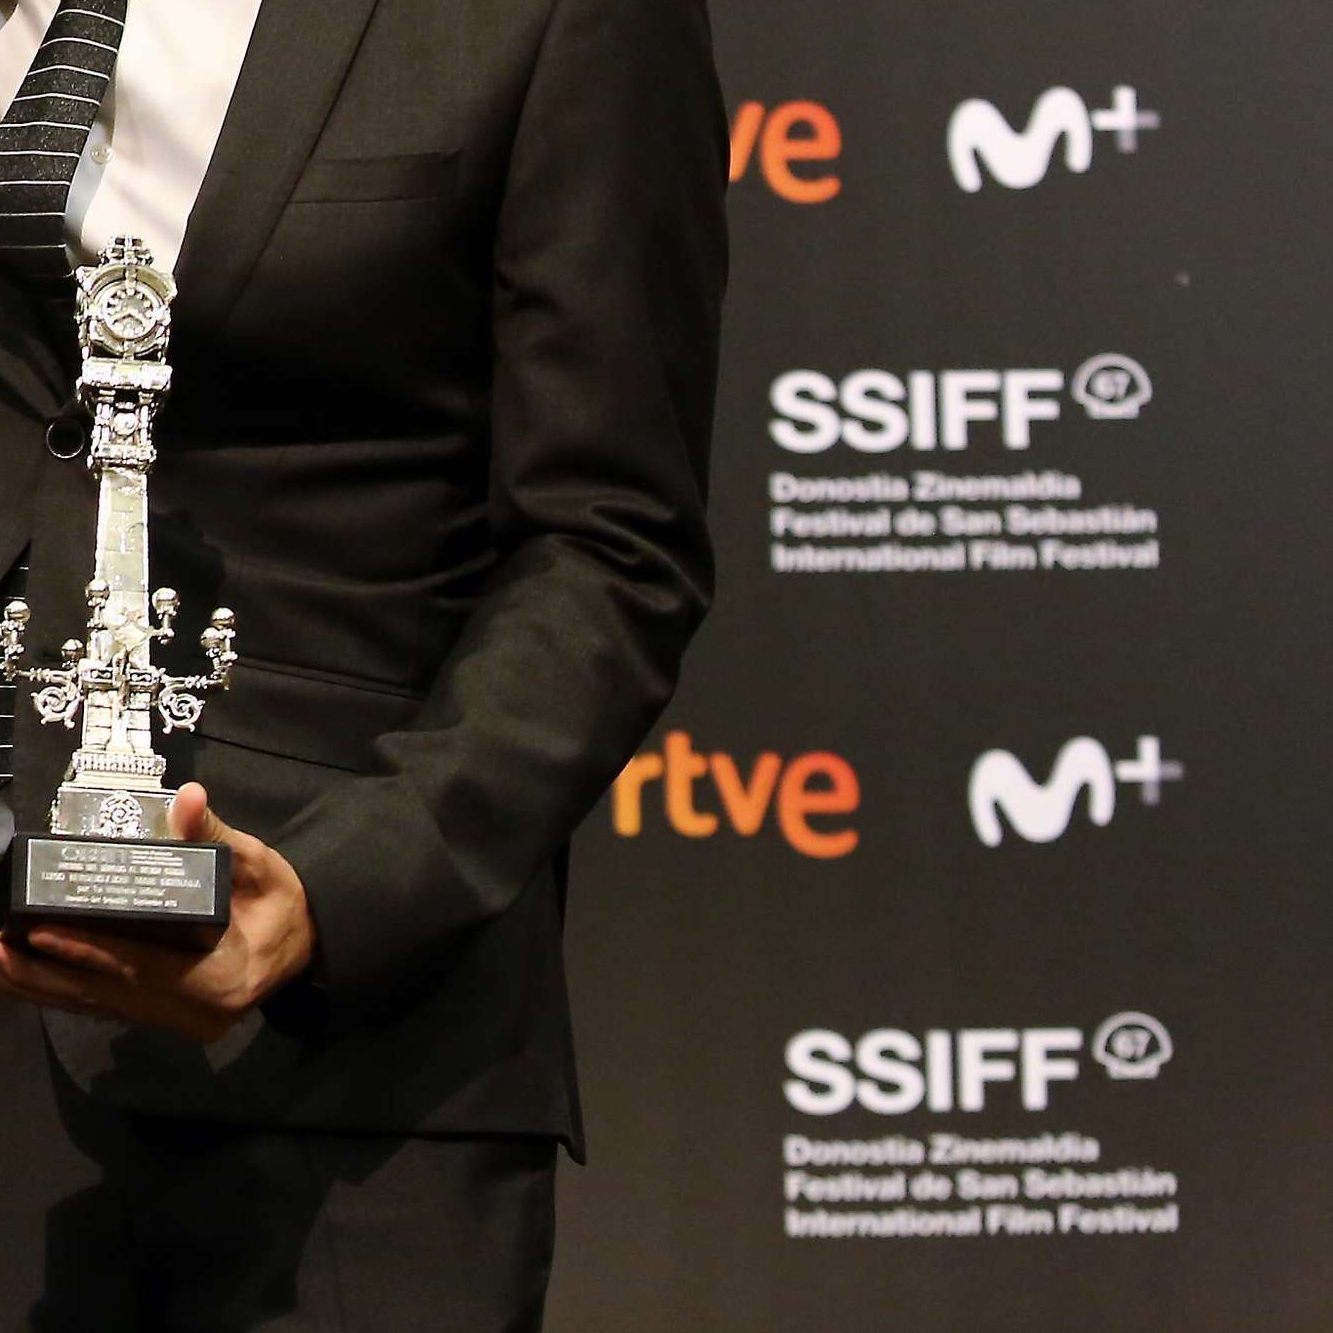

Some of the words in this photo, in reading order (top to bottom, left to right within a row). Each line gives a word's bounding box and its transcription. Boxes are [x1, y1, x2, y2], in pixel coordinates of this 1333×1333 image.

[769, 369, 1063, 454] SSIFF
[769, 471, 909, 503] Donostia
[913, 471, 1082, 500] Zinemaldia
[771, 506, 891, 537] Festival
[894, 507, 933, 537] de
[938, 507, 1000, 536] San
[772, 544, 966, 572] International
[970, 542, 1036, 570] Film
[1040, 539, 1159, 568] Festival
[613, 730, 860, 859] rtve
[783, 1028, 1083, 1115] SSIFF
[783, 1135, 925, 1166] Donostia
[928, 1133, 1099, 1164] Zinemaldia
[785, 1171, 907, 1203] Festival
[911, 1171, 951, 1201] de
[957, 1170, 1020, 1200] San
[785, 1207, 981, 1237] International
[986, 1205, 1054, 1234] Film
[1058, 1203, 1178, 1233] Festival
